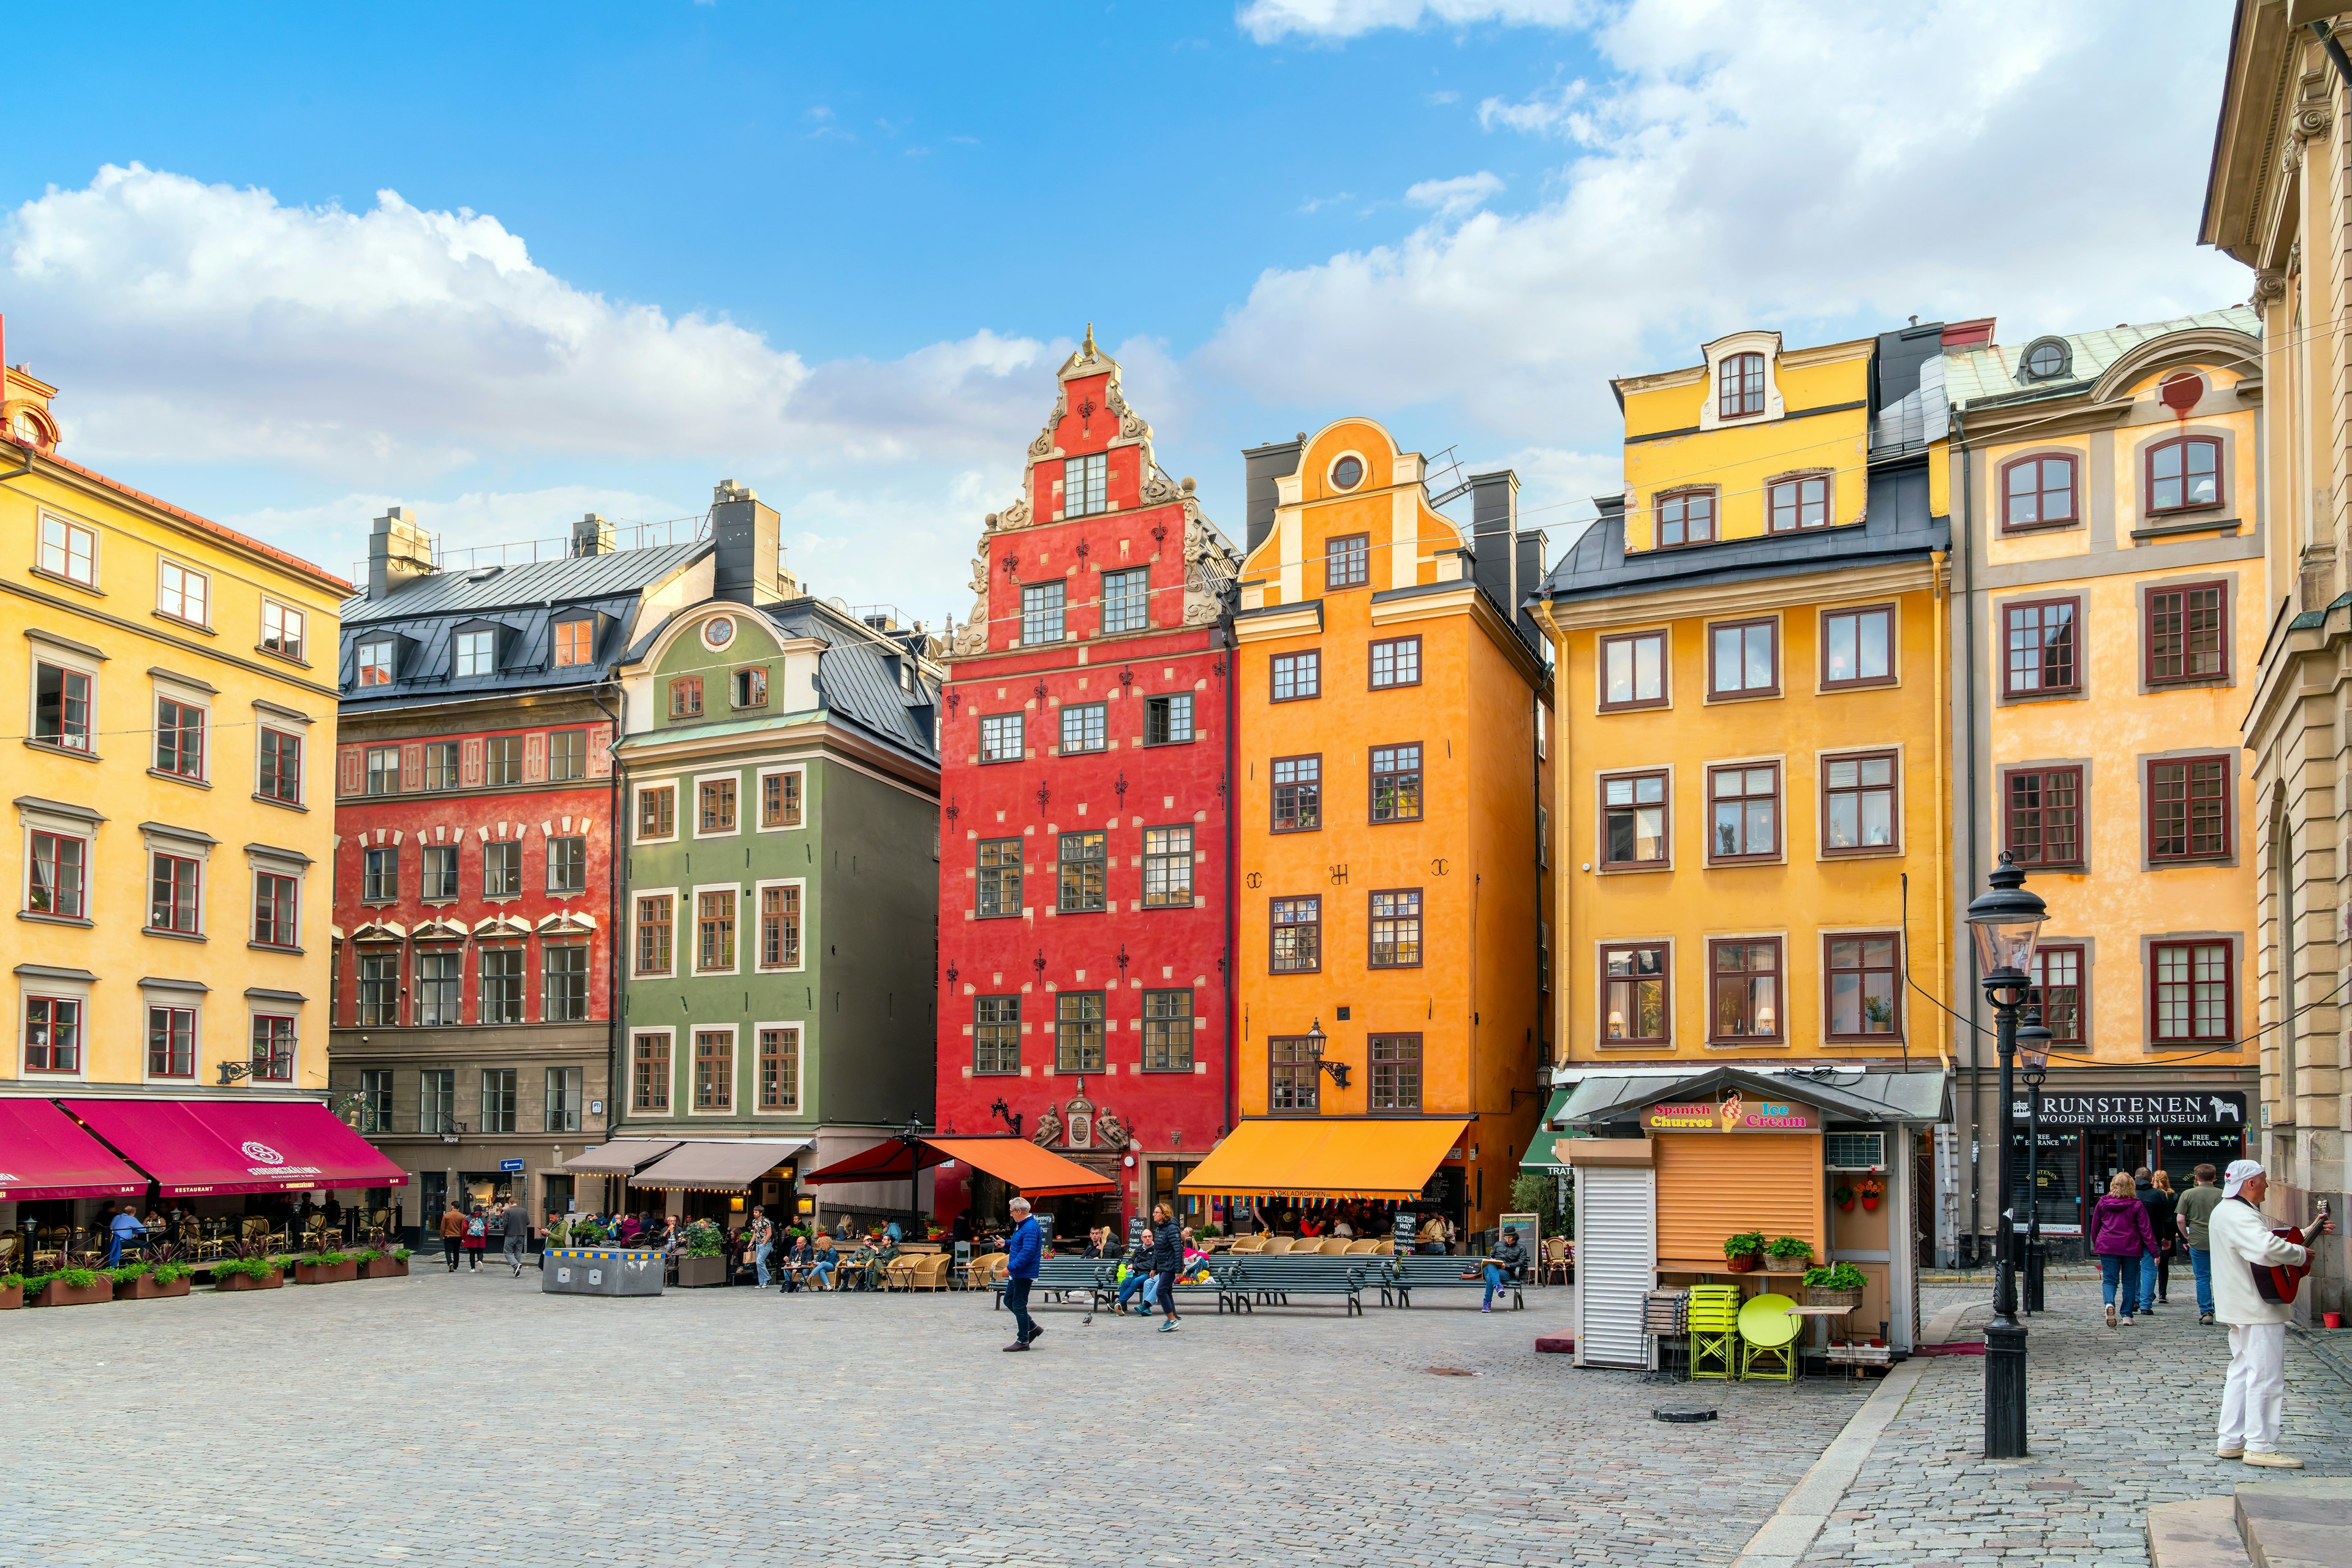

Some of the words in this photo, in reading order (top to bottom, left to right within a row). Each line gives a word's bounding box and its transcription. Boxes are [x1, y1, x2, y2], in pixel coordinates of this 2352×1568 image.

[1654, 1104, 1711, 1117] Spanish
[1762, 1102, 1789, 1115] Ice
[2043, 1096, 2202, 1114] RUNSTENEN
[1651, 1116, 1713, 1128] Churros
[1746, 1114, 1806, 1128] Cream
[2038, 1114, 2095, 1123] WOODEN
[2100, 1114, 2144, 1123] HORSE
[2149, 1114, 2207, 1123] MUSEUM
[1547, 1167, 1575, 1175] TRATT
[2026, 1169, 2059, 1180] RSTENEN
[1130, 1218, 1144, 1227] TAKE
